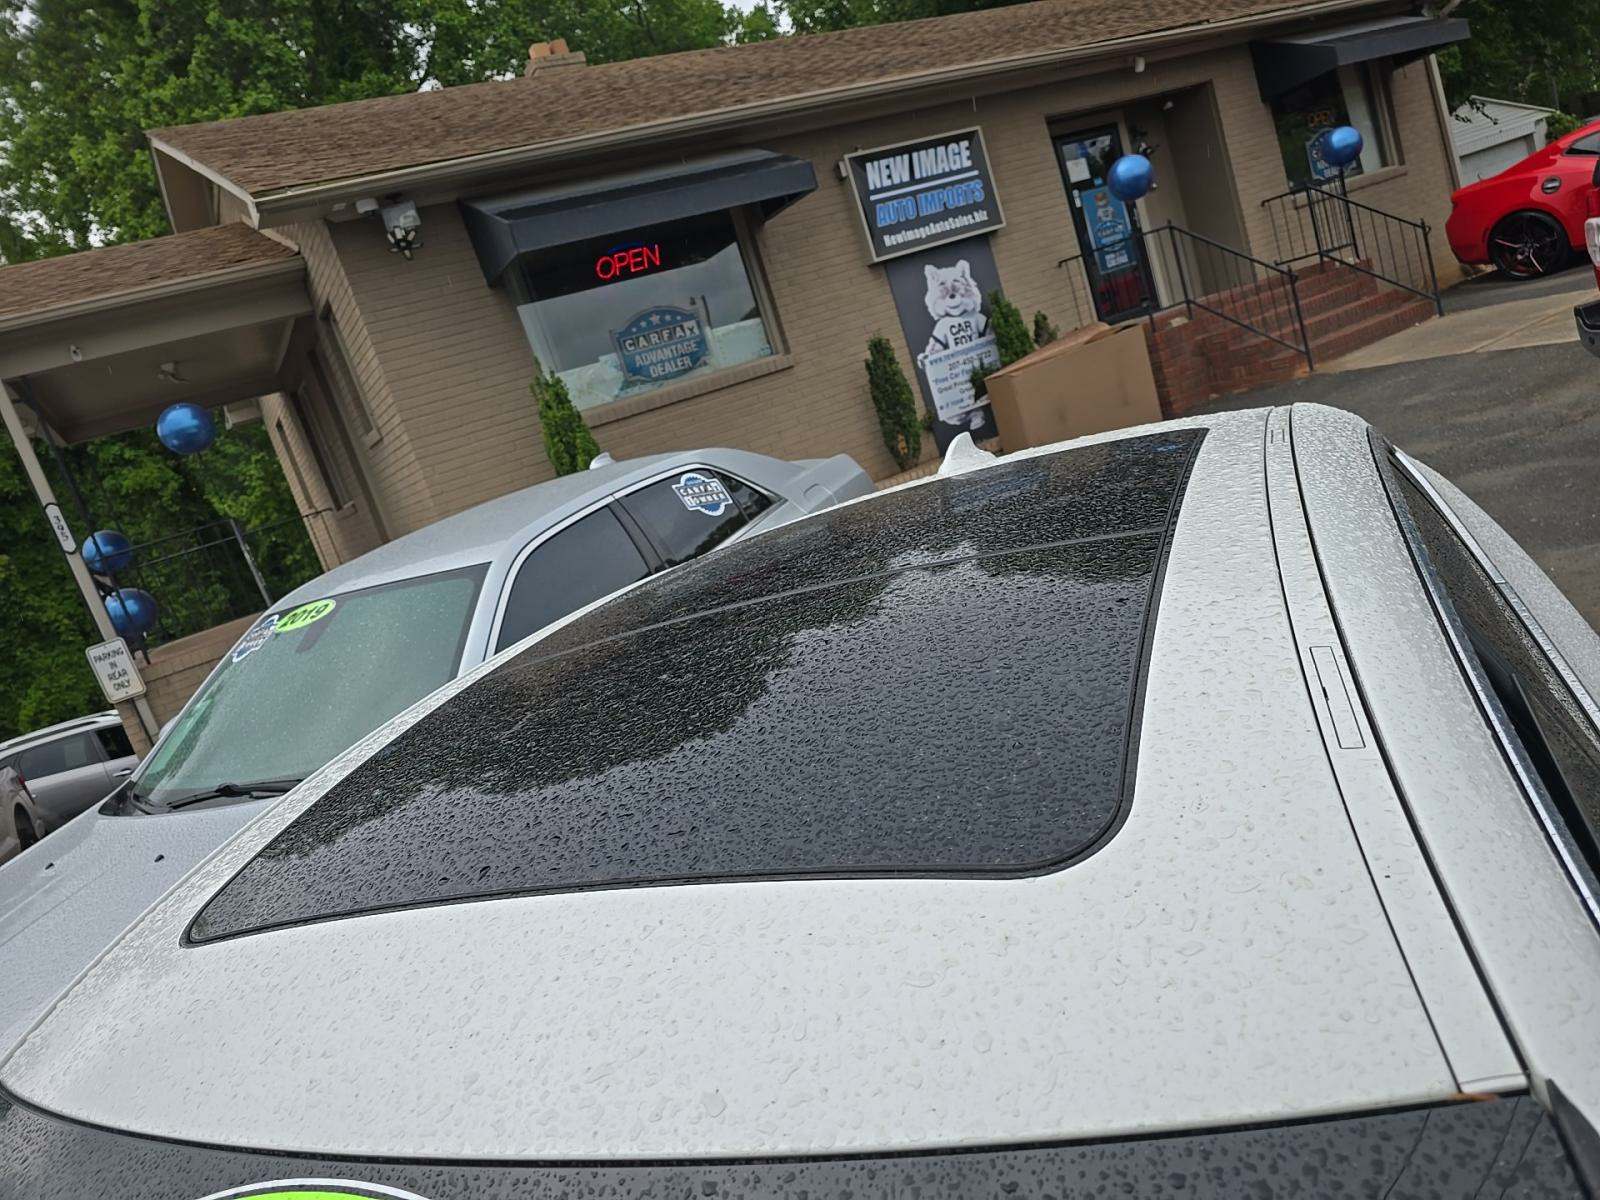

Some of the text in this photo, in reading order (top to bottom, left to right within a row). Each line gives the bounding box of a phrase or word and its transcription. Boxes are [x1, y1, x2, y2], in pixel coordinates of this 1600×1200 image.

[865, 140, 972, 190] NEW IMAGE
[876, 179, 986, 228] AUTO IMPORTS
[596, 244, 661, 280] OPEN
[623, 320, 700, 352] CARFAX
[949, 320, 973, 336] CAR
[954, 335, 973, 346] FOX
[634, 339, 699, 367] ADVANTAGE
[649, 356, 693, 378] DEALER
[278, 602, 330, 630] 2019
[93, 647, 124, 664] PARKING
[108, 660, 118, 670] IN
[107, 668, 128, 681] REAR
[113, 679, 130, 691] ONLY
